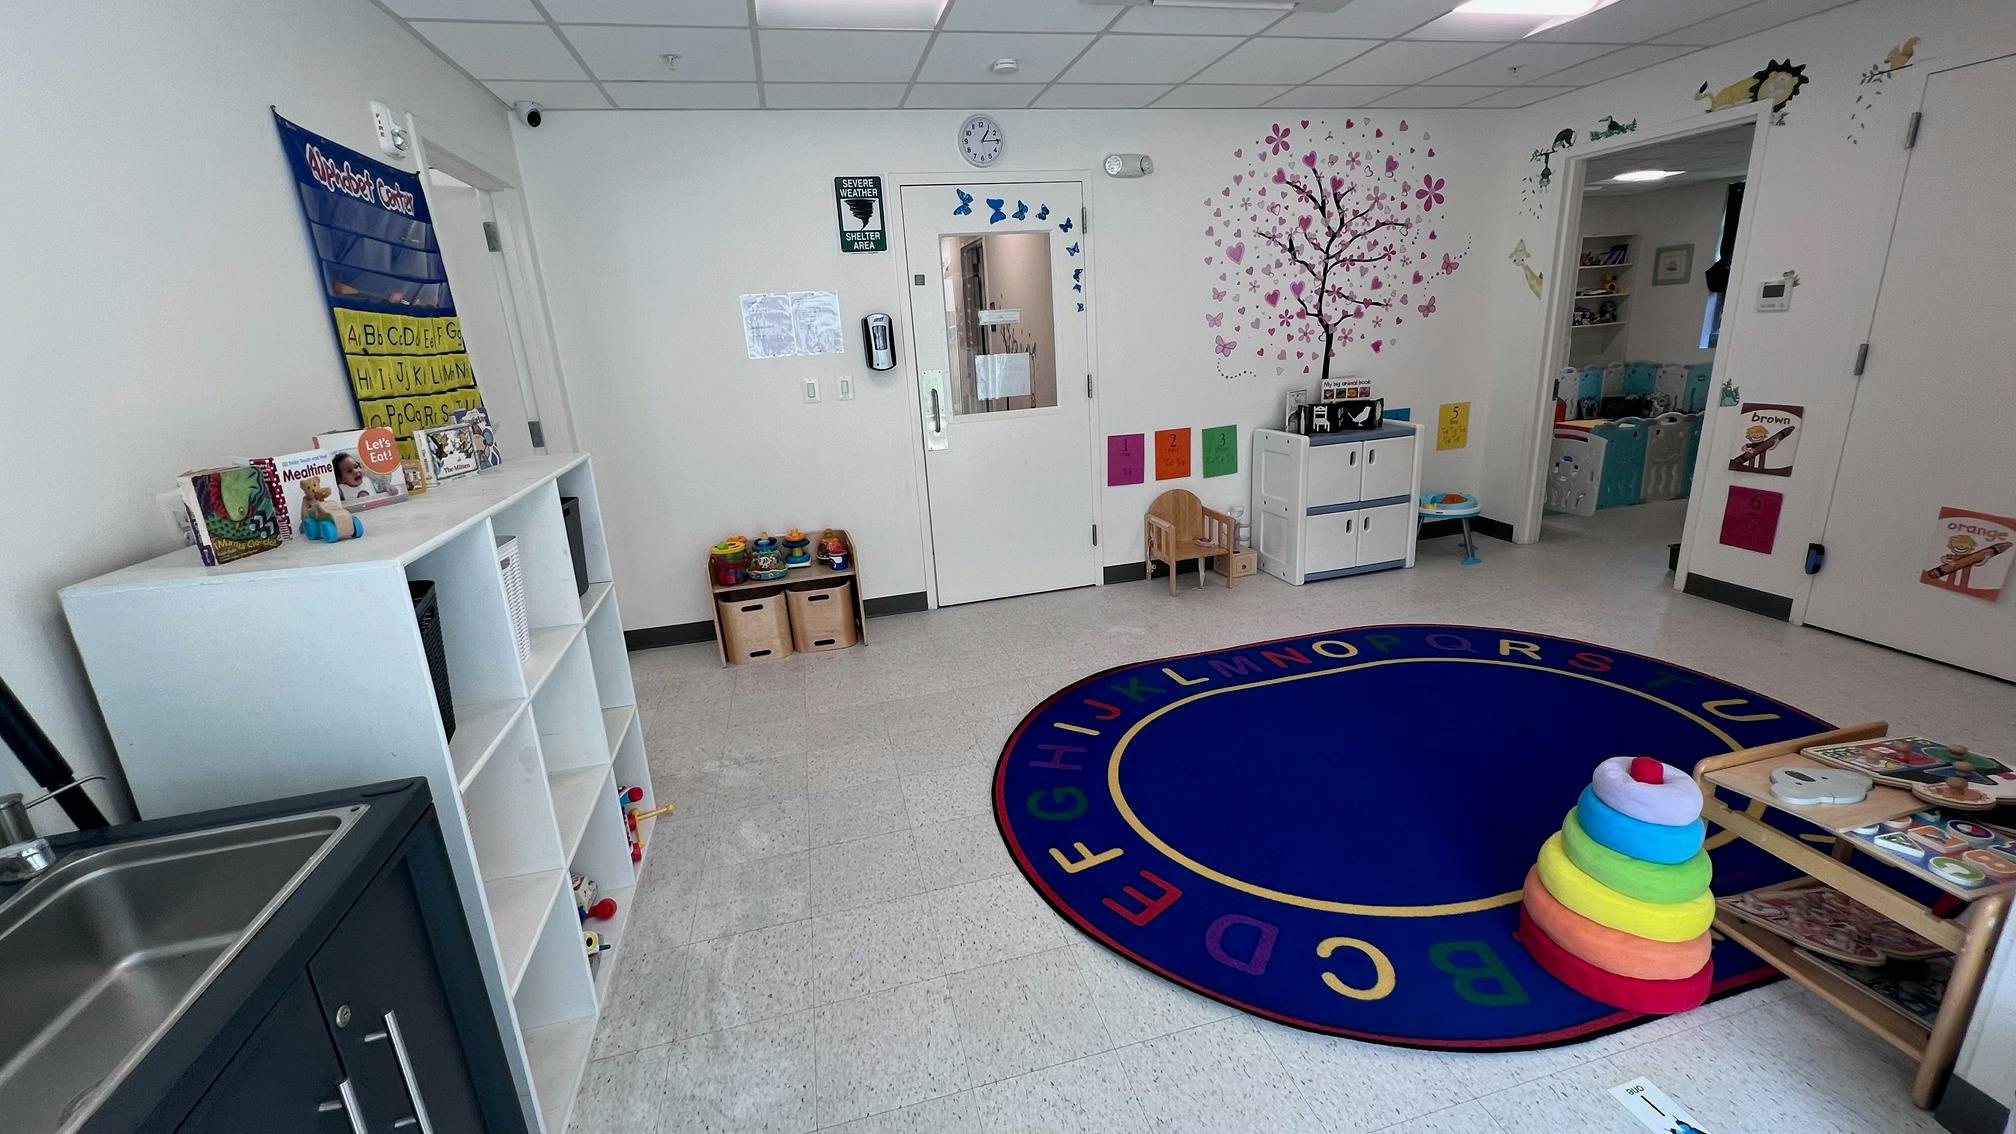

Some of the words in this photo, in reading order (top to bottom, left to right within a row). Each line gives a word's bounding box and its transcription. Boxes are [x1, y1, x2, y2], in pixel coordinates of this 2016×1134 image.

[375, 113, 385, 137] FIRE
[306, 144, 375, 203] Alphabet
[376, 178, 414, 216] Center
[842, 179, 874, 188] SEVERE
[840, 188, 878, 198] WEATHER
[845, 232, 881, 241] SHELTER
[853, 241, 875, 250] AREA
[1452, 406, 1459, 419] 5
[1751, 412, 1791, 425] brown
[365, 438, 391, 451] Let's
[1169, 433, 1177, 448] 2
[1219, 433, 1226, 448] 3
[370, 450, 393, 463] Eat!
[283, 463, 333, 482] Mealtime
[1948, 522, 2009, 542] orange
[1312, 639, 1359, 658] O
[1366, 634, 1402, 653] P
[1426, 634, 1480, 653] Q
[1499, 639, 1543, 661] R
[1208, 654, 1265, 677] M
[1261, 647, 1312, 668] N
[1568, 651, 1616, 671] S
[1162, 667, 1210, 688] L
[1646, 670, 1697, 688] T
[1112, 677, 1164, 702] K
[1083, 699, 1121, 720] J
[1702, 699, 1781, 722] U
[1054, 723, 1101, 736] I
[1029, 743, 1086, 771] H
[1026, 786, 1087, 820] G
[1049, 841, 1123, 873] F
[1102, 869, 1182, 926] E
[1204, 914, 1279, 976] D
[1316, 937, 1396, 1000] C
[1429, 942, 1528, 1005] B
[1626, 1085, 1644, 1095] one
